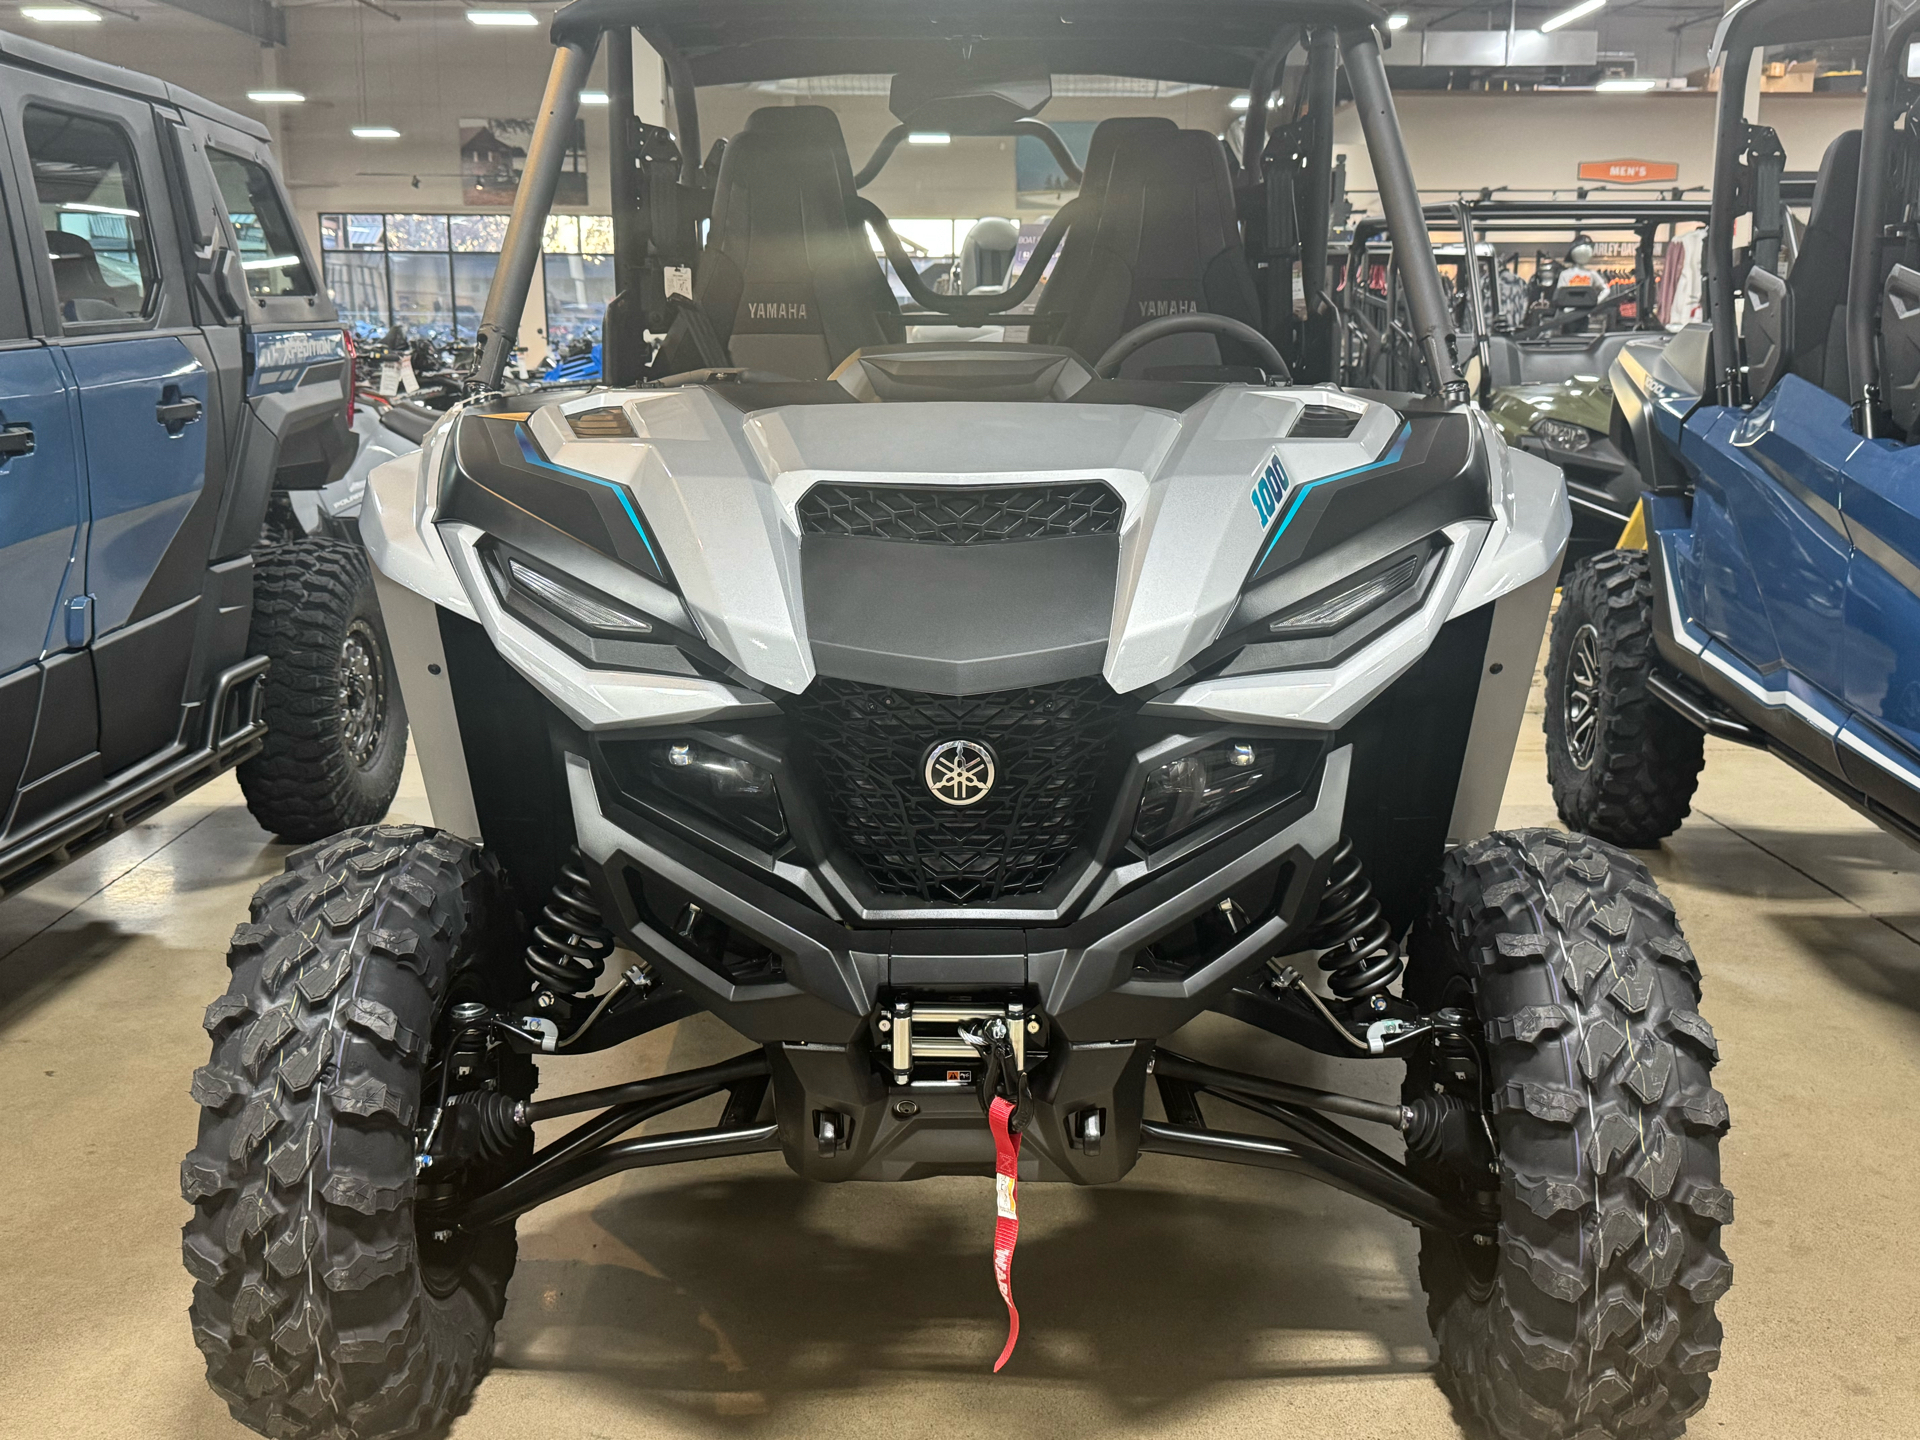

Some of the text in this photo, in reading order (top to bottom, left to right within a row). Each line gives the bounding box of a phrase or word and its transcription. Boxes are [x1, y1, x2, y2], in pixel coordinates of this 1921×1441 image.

[1610, 166, 1646, 177] MEN'S
[748, 302, 807, 319] YAMAHA
[1138, 300, 1198, 316] YAMAHA
[1250, 453, 1290, 530] 1000
